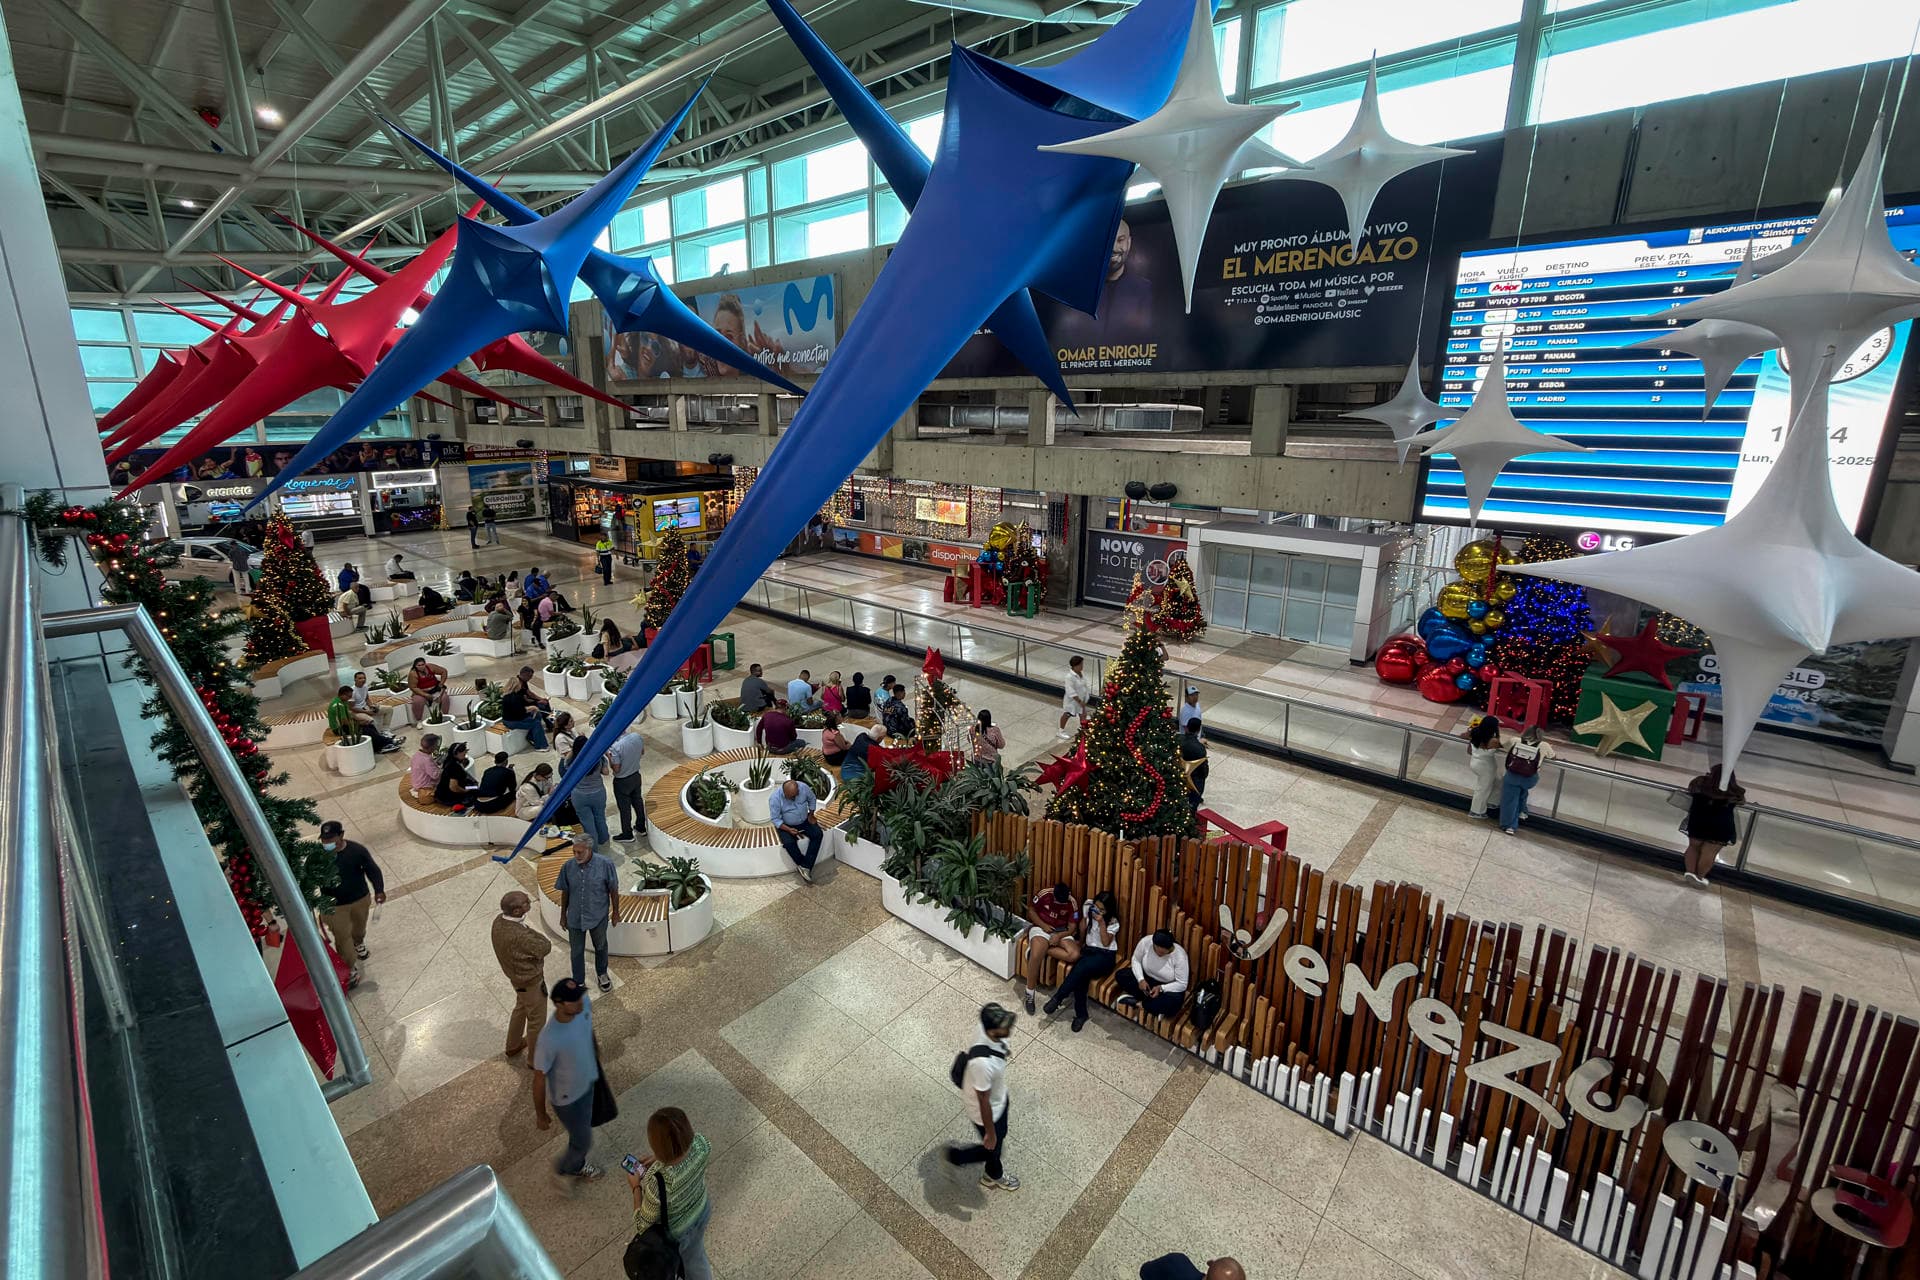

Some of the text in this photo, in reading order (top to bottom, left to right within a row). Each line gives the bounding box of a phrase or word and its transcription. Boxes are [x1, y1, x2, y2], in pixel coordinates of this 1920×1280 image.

[1705, 224, 1762, 235] AEROPUERTO
[1234, 241, 1257, 254] MUY
[1260, 234, 1307, 250] PRONTO
[1310, 230, 1351, 244] ÁLBUM
[1375, 221, 1409, 236] VIVO
[1222, 236, 1419, 280] EL MERENGAZO
[1635, 256, 1667, 264] PREV.
[1668, 253, 1693, 261] PTA.
[1497, 266, 1529, 275] VUELO
[1545, 261, 1589, 271] DESTINO
[1231, 272, 1394, 296] ESCUCHA TODA MI MÚSICA POR
[1557, 278, 1593, 287] CURAZAO
[1270, 294, 1290, 302] Spotify
[1300, 291, 1322, 300] Music
[1336, 288, 1359, 297] YouTube
[1377, 284, 1404, 292] DEEZER
[1488, 297, 1519, 307] wingo
[1554, 293, 1585, 302] BOGOTA
[1254, 309, 1362, 325] @OMARENRIQUEMUSIC
[1552, 308, 1588, 316] CURAZAO
[1549, 322, 1585, 330] CURAZAO
[1547, 337, 1578, 345] PANAMA
[1872, 338, 1882, 348] 3
[792, 344, 829, 364] conectan
[1057, 343, 1158, 362] OMAR ENRIQUE
[1544, 352, 1576, 360] PANAMA
[1861, 353, 1871, 363] 4
[1060, 361, 1068, 369] EL
[1100, 359, 1113, 368] DEL
[1114, 358, 1152, 367] MERENGUE
[1844, 364, 1853, 373] 5
[206, 485, 254, 497] GIORGIO
[1603, 535, 1633, 552] LG
[1100, 553, 1143, 571] HOTEL
